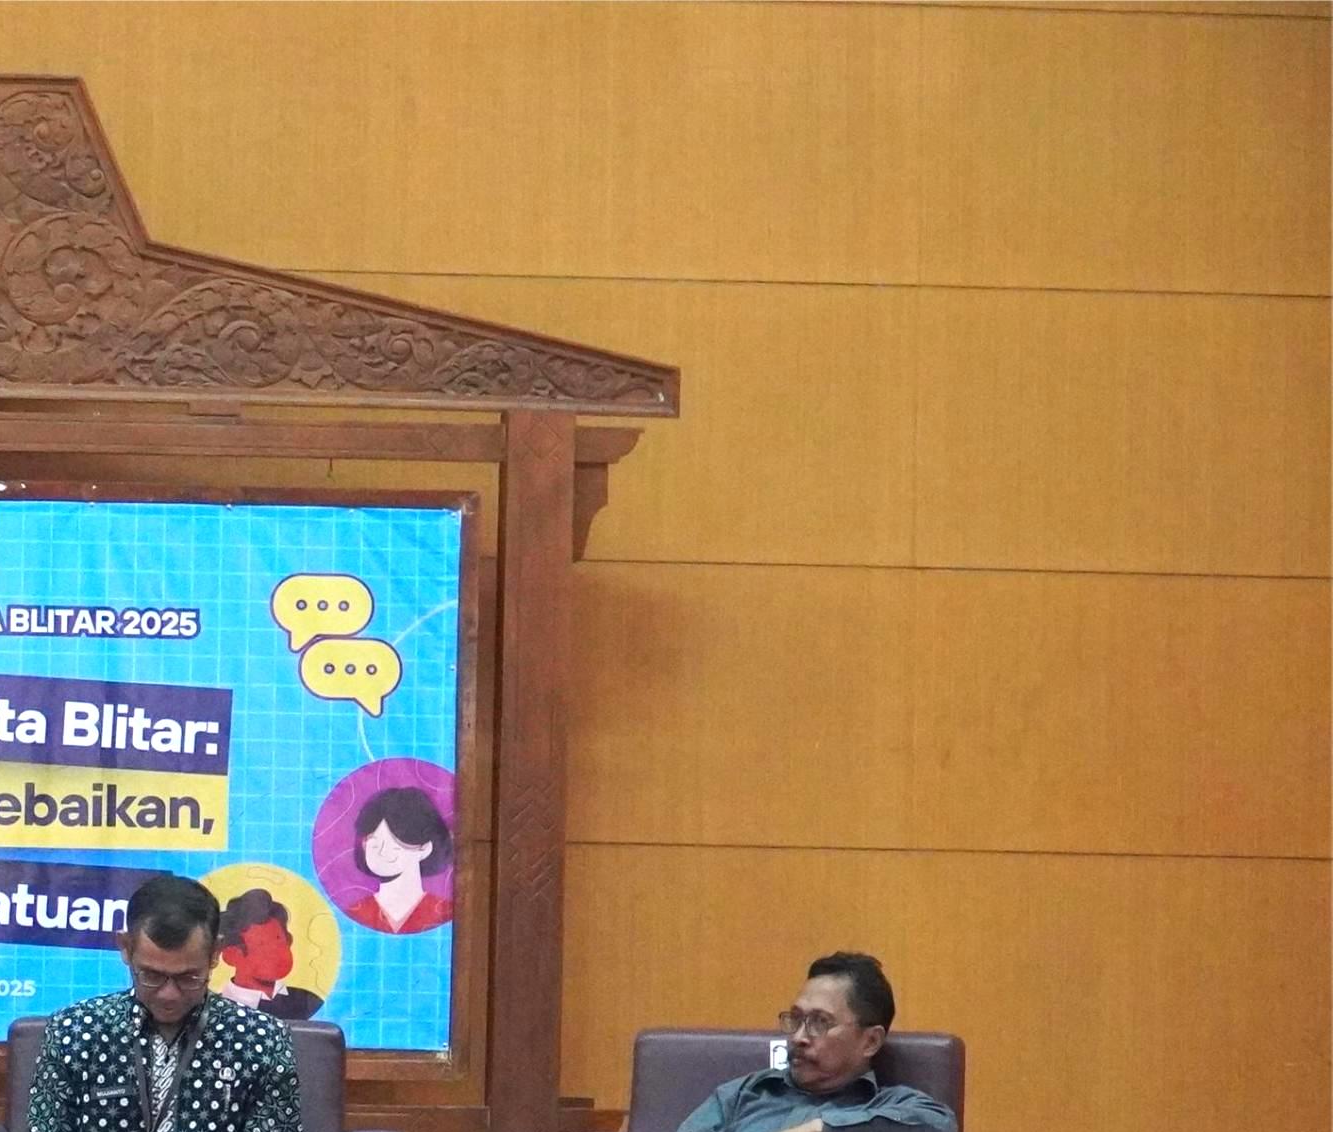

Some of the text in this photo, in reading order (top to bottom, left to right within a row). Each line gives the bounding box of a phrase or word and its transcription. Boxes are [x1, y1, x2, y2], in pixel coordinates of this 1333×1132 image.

[10, 608, 116, 635] BLITAR
[122, 610, 198, 637] 2025
[62, 701, 220, 755] Blitar:
